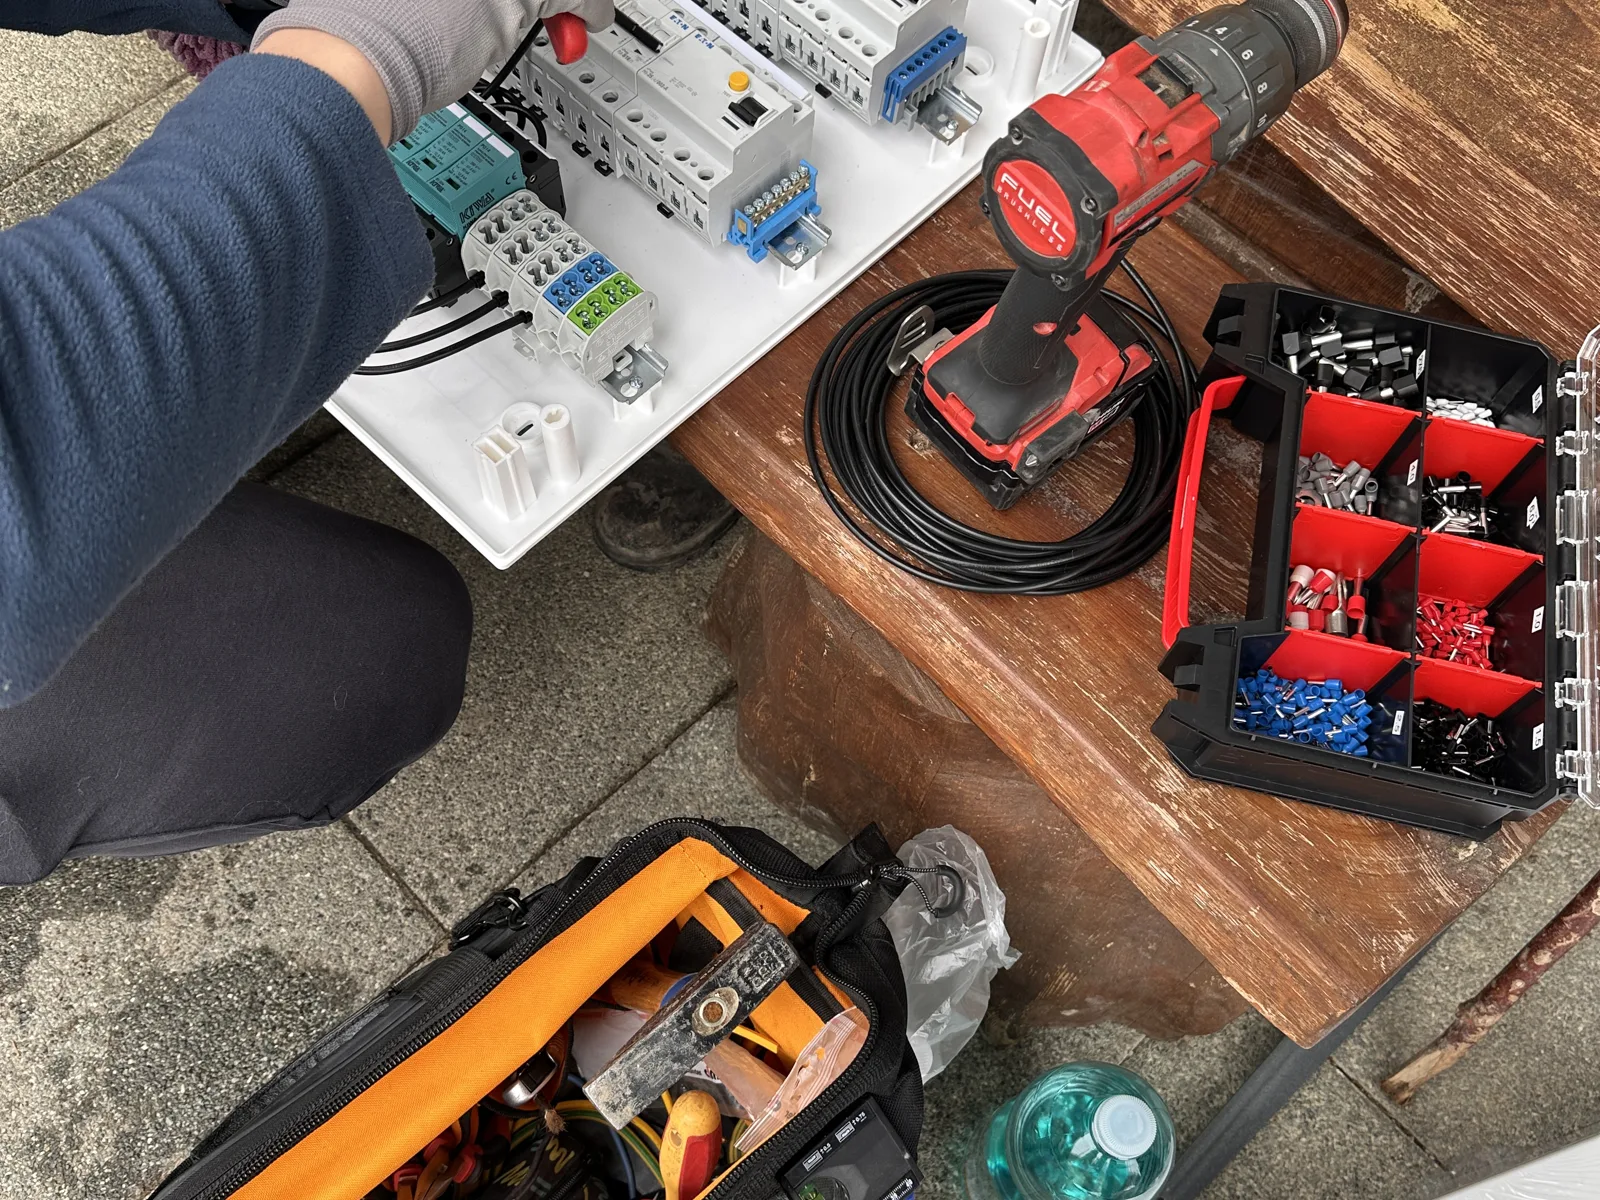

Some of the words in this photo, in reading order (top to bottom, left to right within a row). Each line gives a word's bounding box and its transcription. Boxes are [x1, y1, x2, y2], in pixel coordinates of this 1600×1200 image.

[1215, 26, 1228, 35] 4
[1241, 49, 1254, 60] 6
[1257, 82, 1268, 94] 8
[1257, 113, 1268, 128] 10
[1001, 172, 1066, 243] FUEL
[997, 185, 1063, 252] BRUSHLESS
